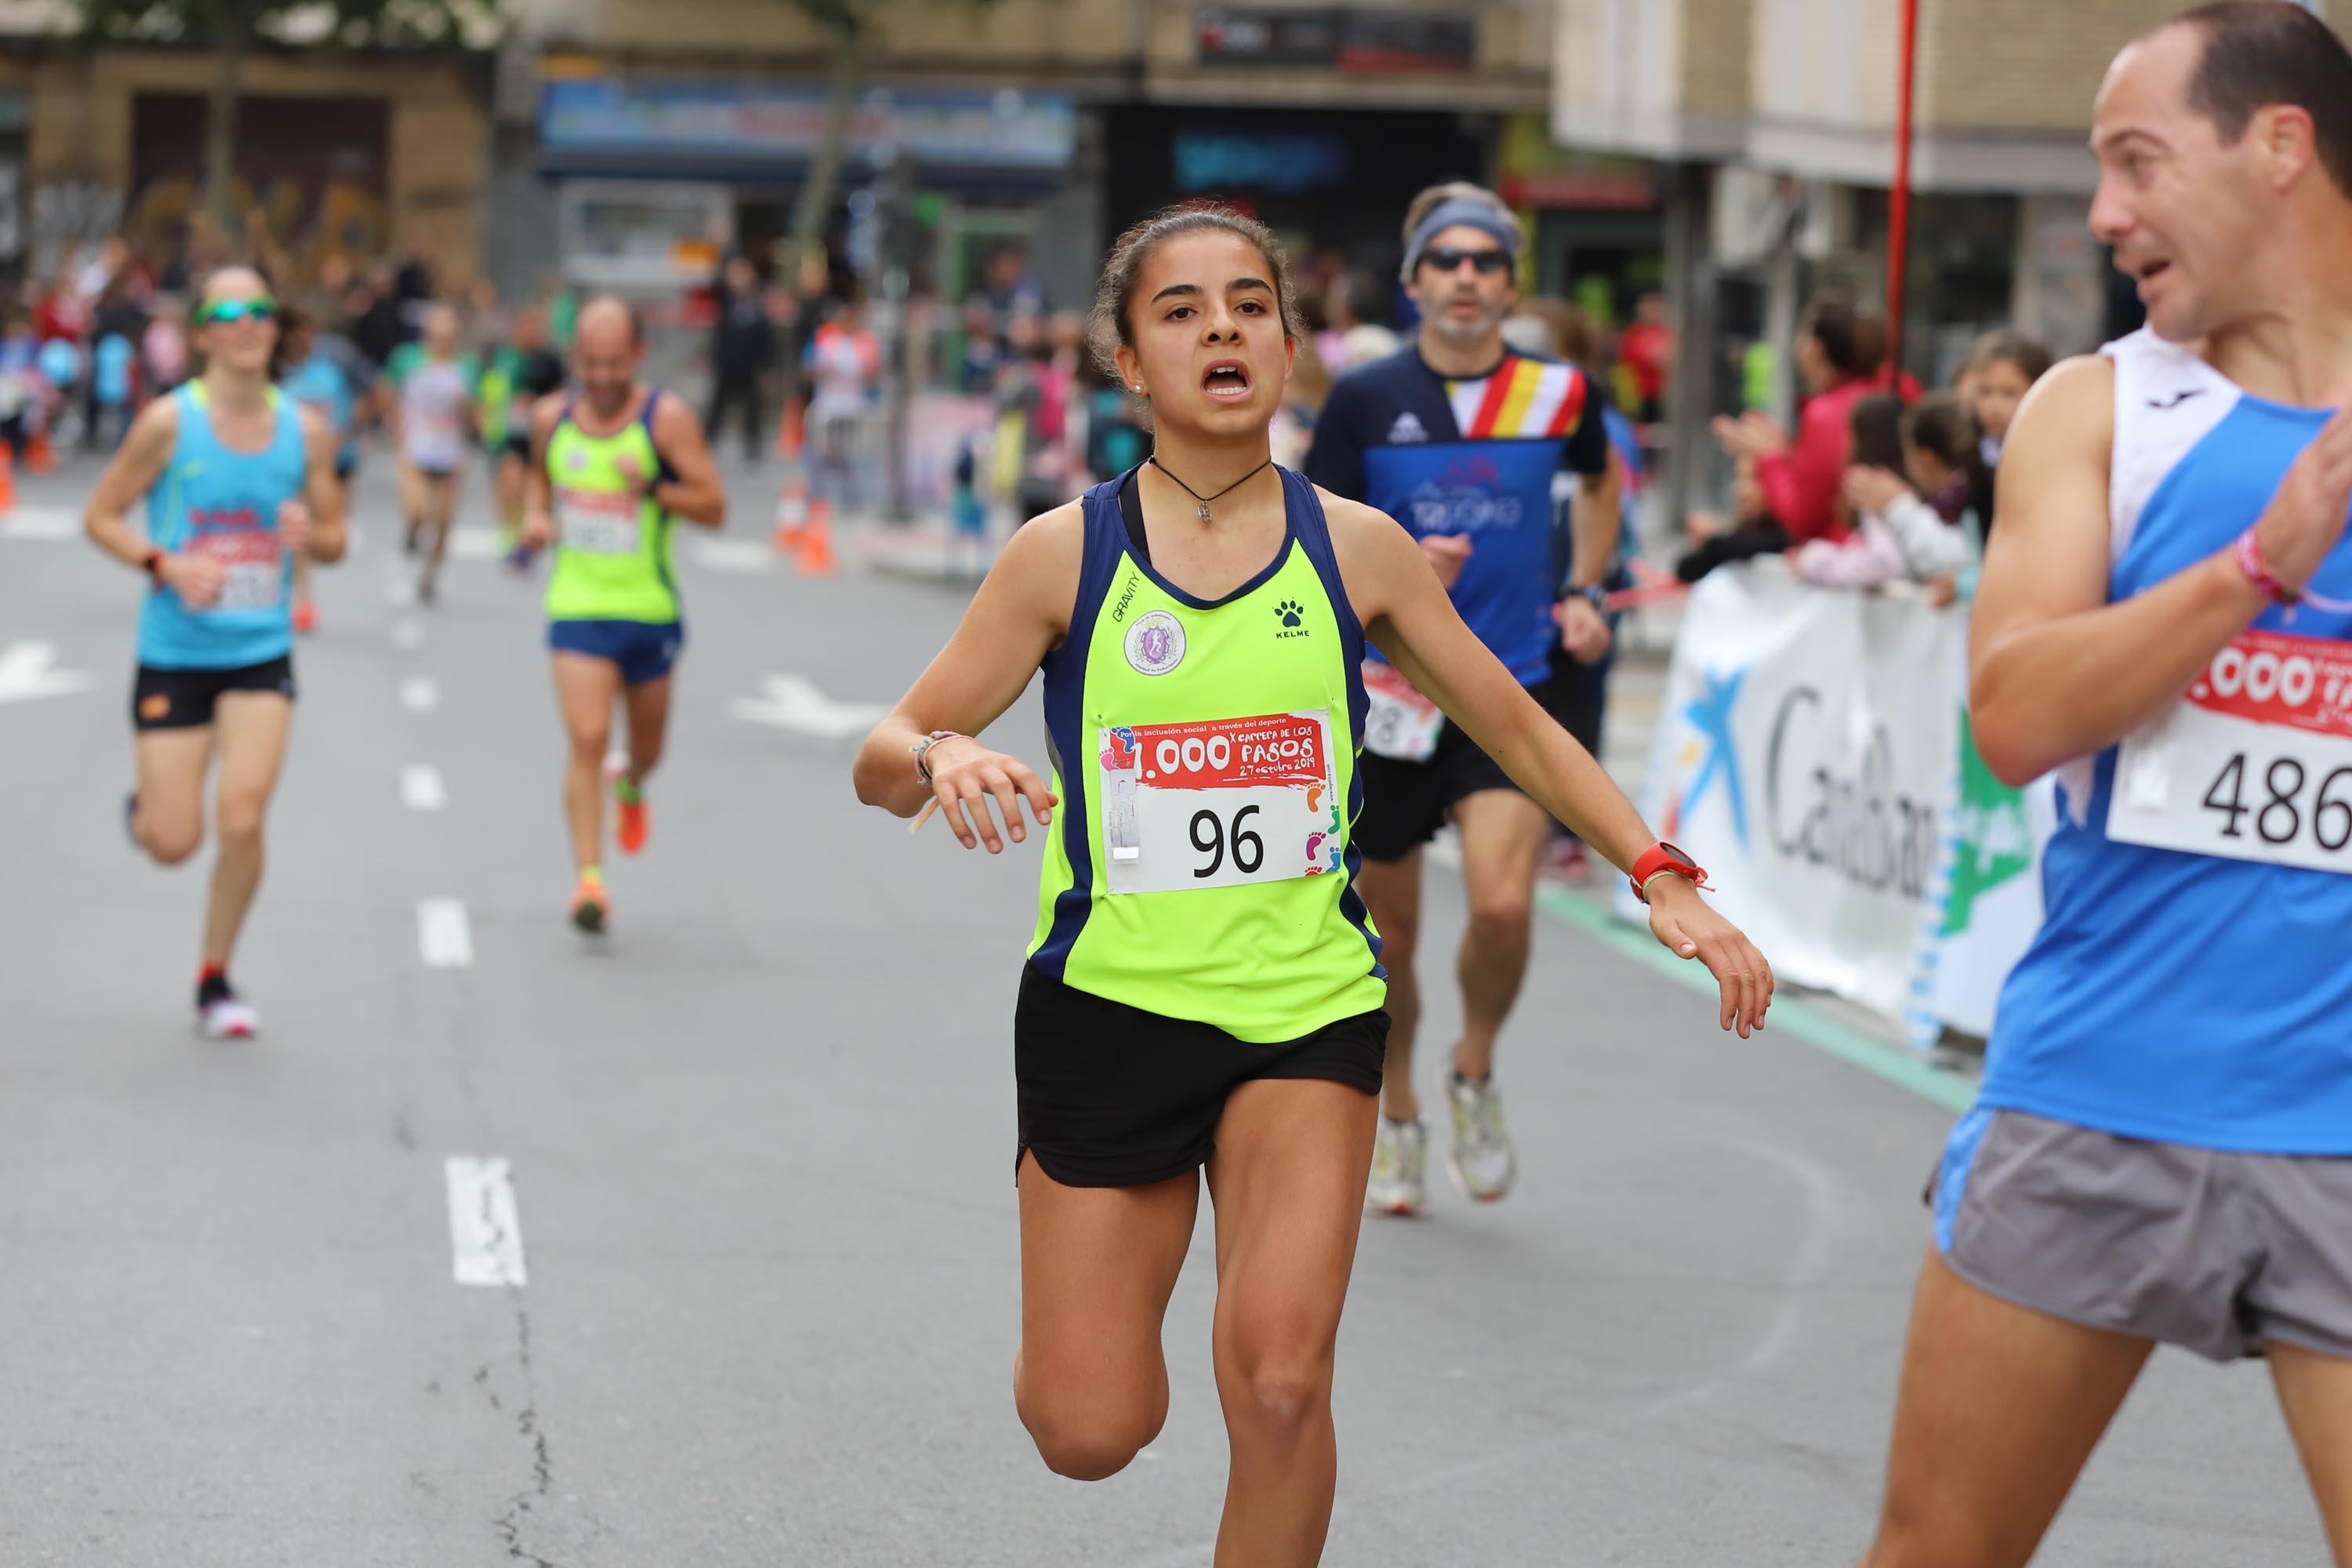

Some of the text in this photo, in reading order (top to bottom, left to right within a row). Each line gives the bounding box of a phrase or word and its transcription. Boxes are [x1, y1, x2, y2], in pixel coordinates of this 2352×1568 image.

[1112, 571, 1139, 622] GRAVITY
[1276, 630, 1310, 639] KELME
[2191, 645, 2315, 707] .000
[1144, 727, 1181, 737] inclusión
[1183, 724, 1207, 734] social
[1218, 722, 1243, 731] través
[1244, 719, 1257, 728] del
[1258, 717, 1287, 727] deporte
[1229, 726, 1312, 744] X CARRERA DE LOS
[1130, 734, 1231, 780] 1.000
[1239, 757, 1316, 777] 27 octubre 2019
[1240, 737, 1314, 764] PASOS
[2201, 751, 2352, 851] 486
[1189, 804, 1264, 878] 96
